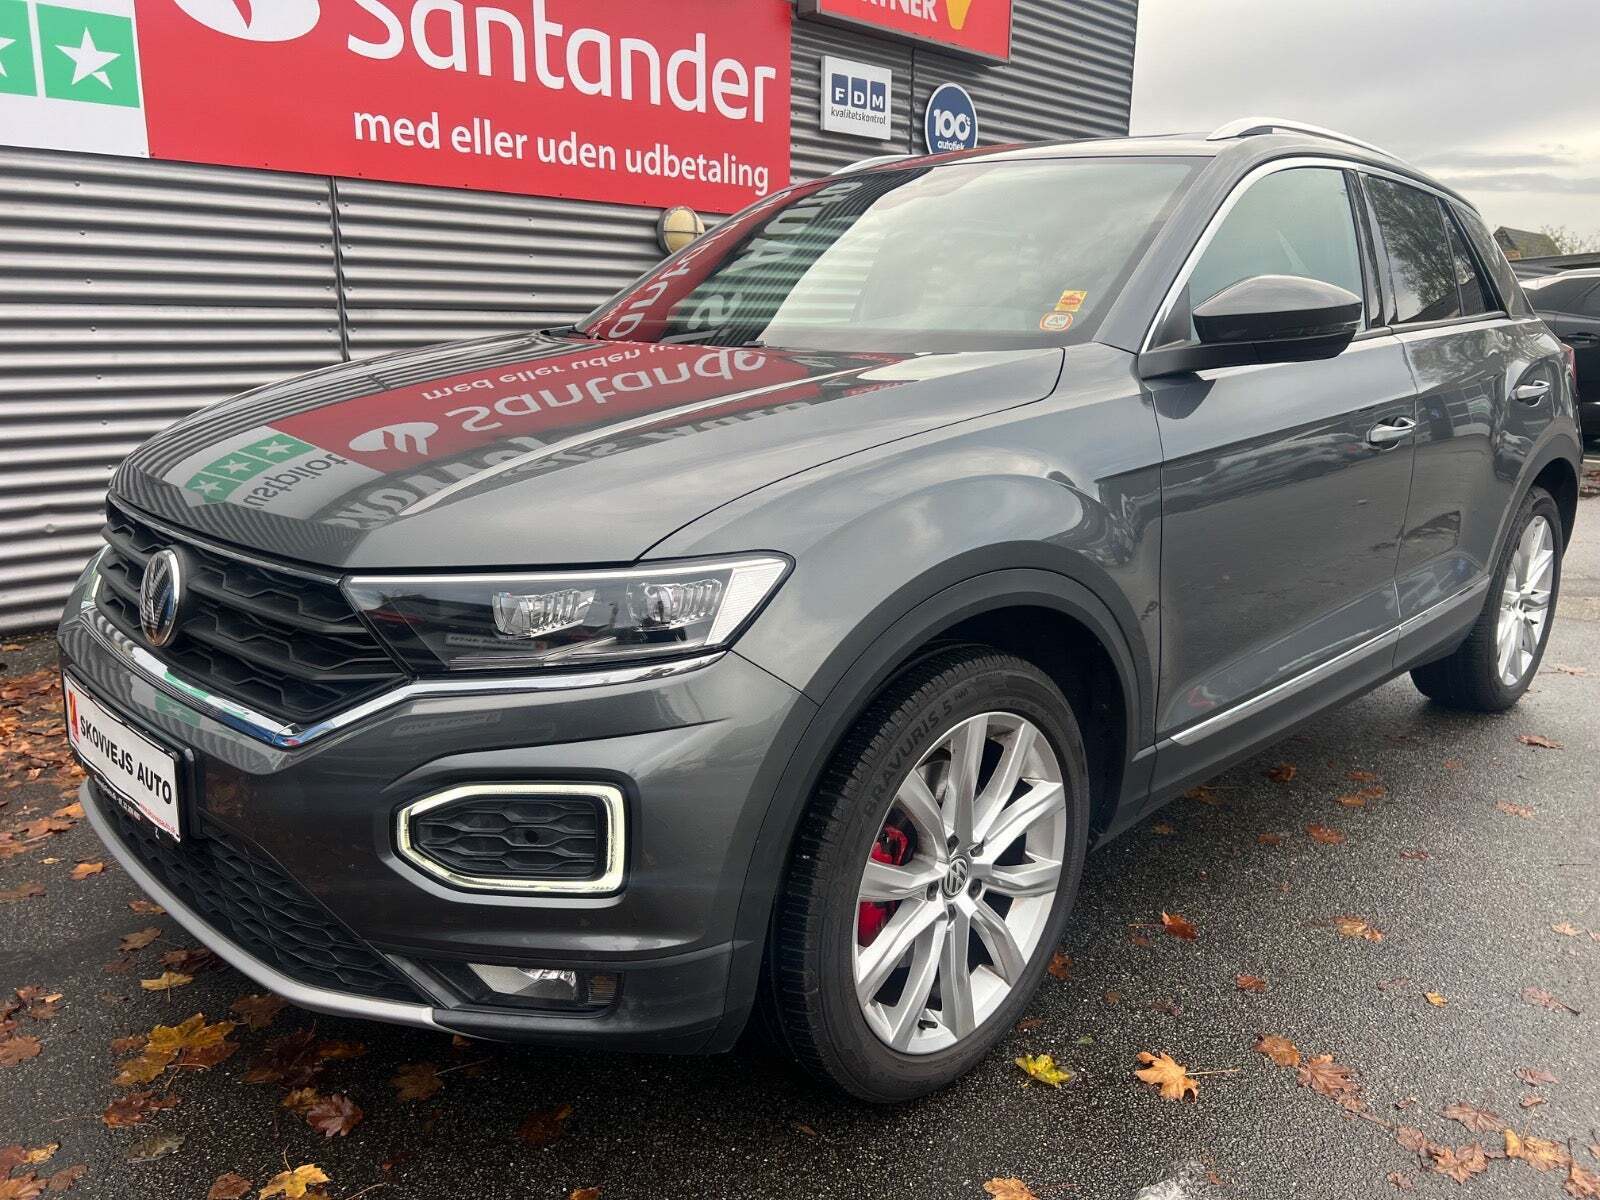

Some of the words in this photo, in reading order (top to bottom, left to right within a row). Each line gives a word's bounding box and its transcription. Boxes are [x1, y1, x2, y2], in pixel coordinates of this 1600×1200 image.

[347, 0, 776, 123] Santander
[835, 87, 883, 109] FDM
[353, 111, 440, 150] med
[451, 117, 528, 159] eller
[537, 131, 616, 170] uden
[625, 144, 769, 195] udbetaling
[831, 106, 886, 124] kvalitetskontrol
[80, 715, 134, 776] SKOVVEJS
[137, 762, 172, 805] AUTO
[863, 710, 939, 818] BRAVURIS
